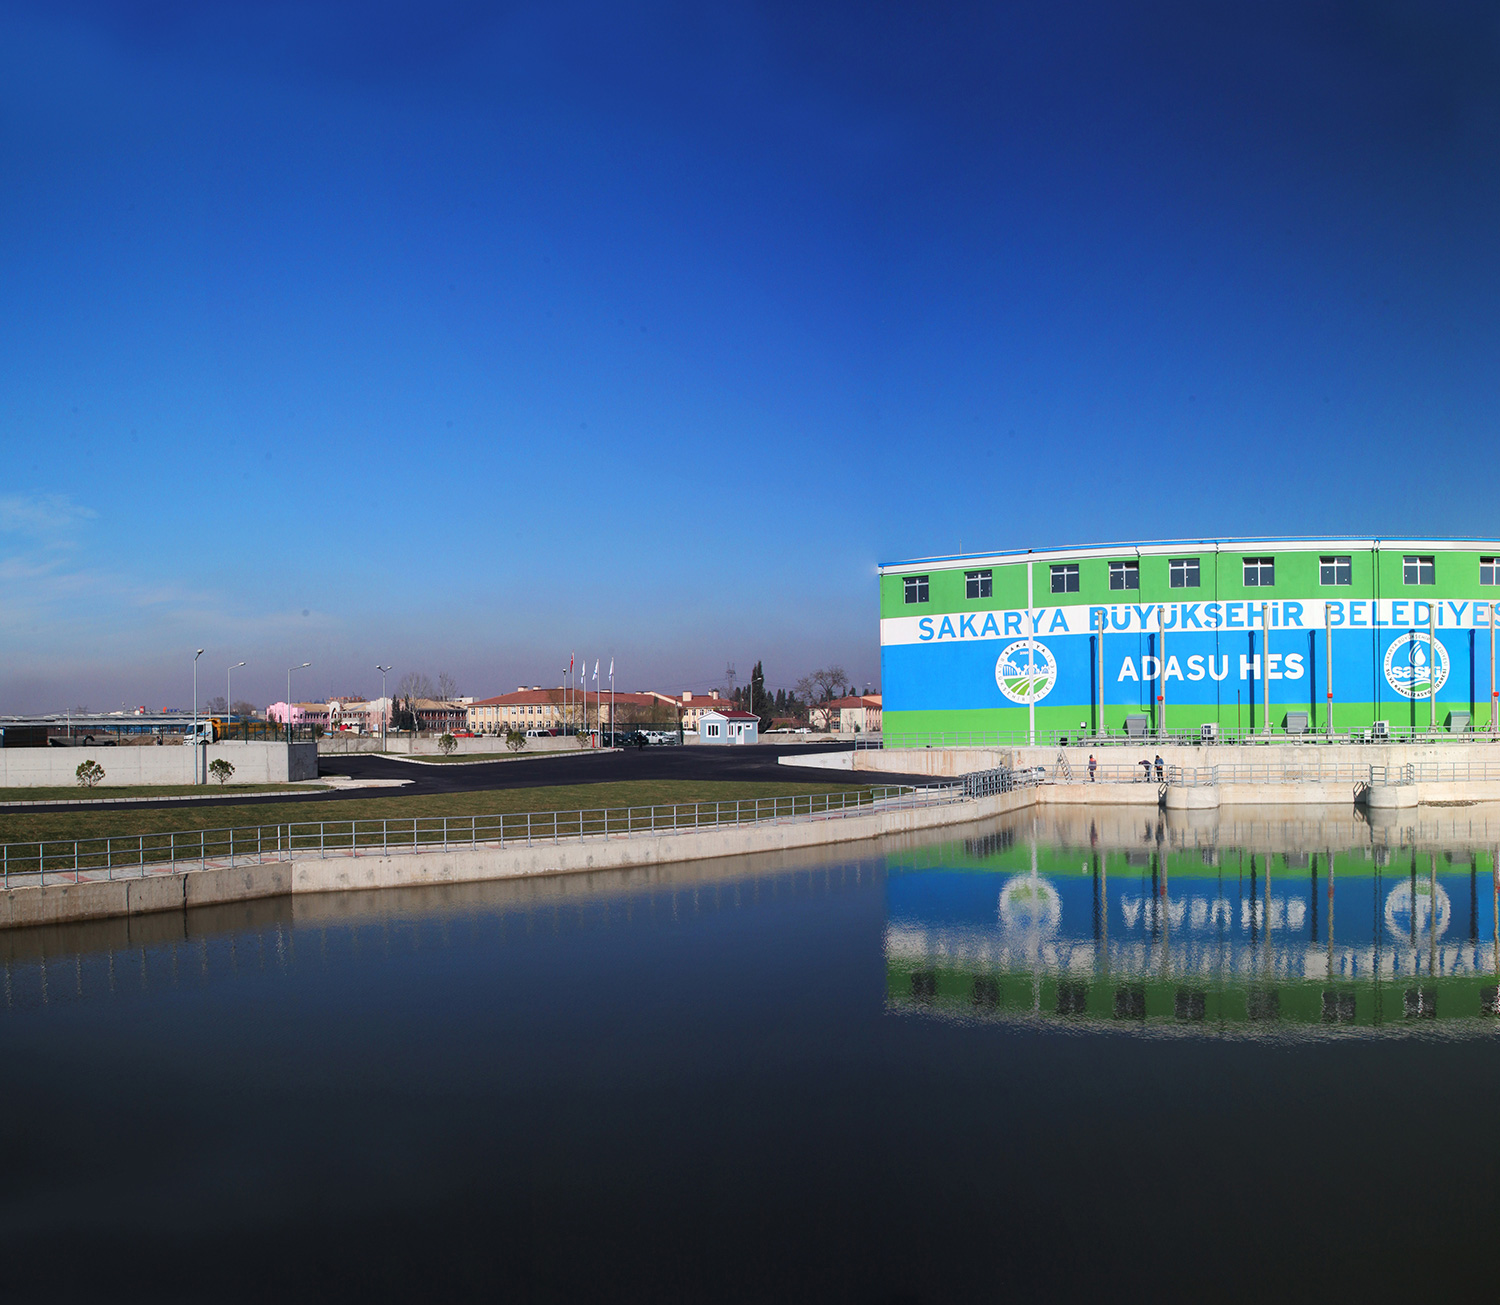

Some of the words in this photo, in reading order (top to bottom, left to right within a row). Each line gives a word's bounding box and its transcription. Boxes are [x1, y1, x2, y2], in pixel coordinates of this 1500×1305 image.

[918, 608, 1070, 641] SAKARYA
[1117, 654, 1229, 682] ADASU
[1239, 652, 1305, 680] HES
